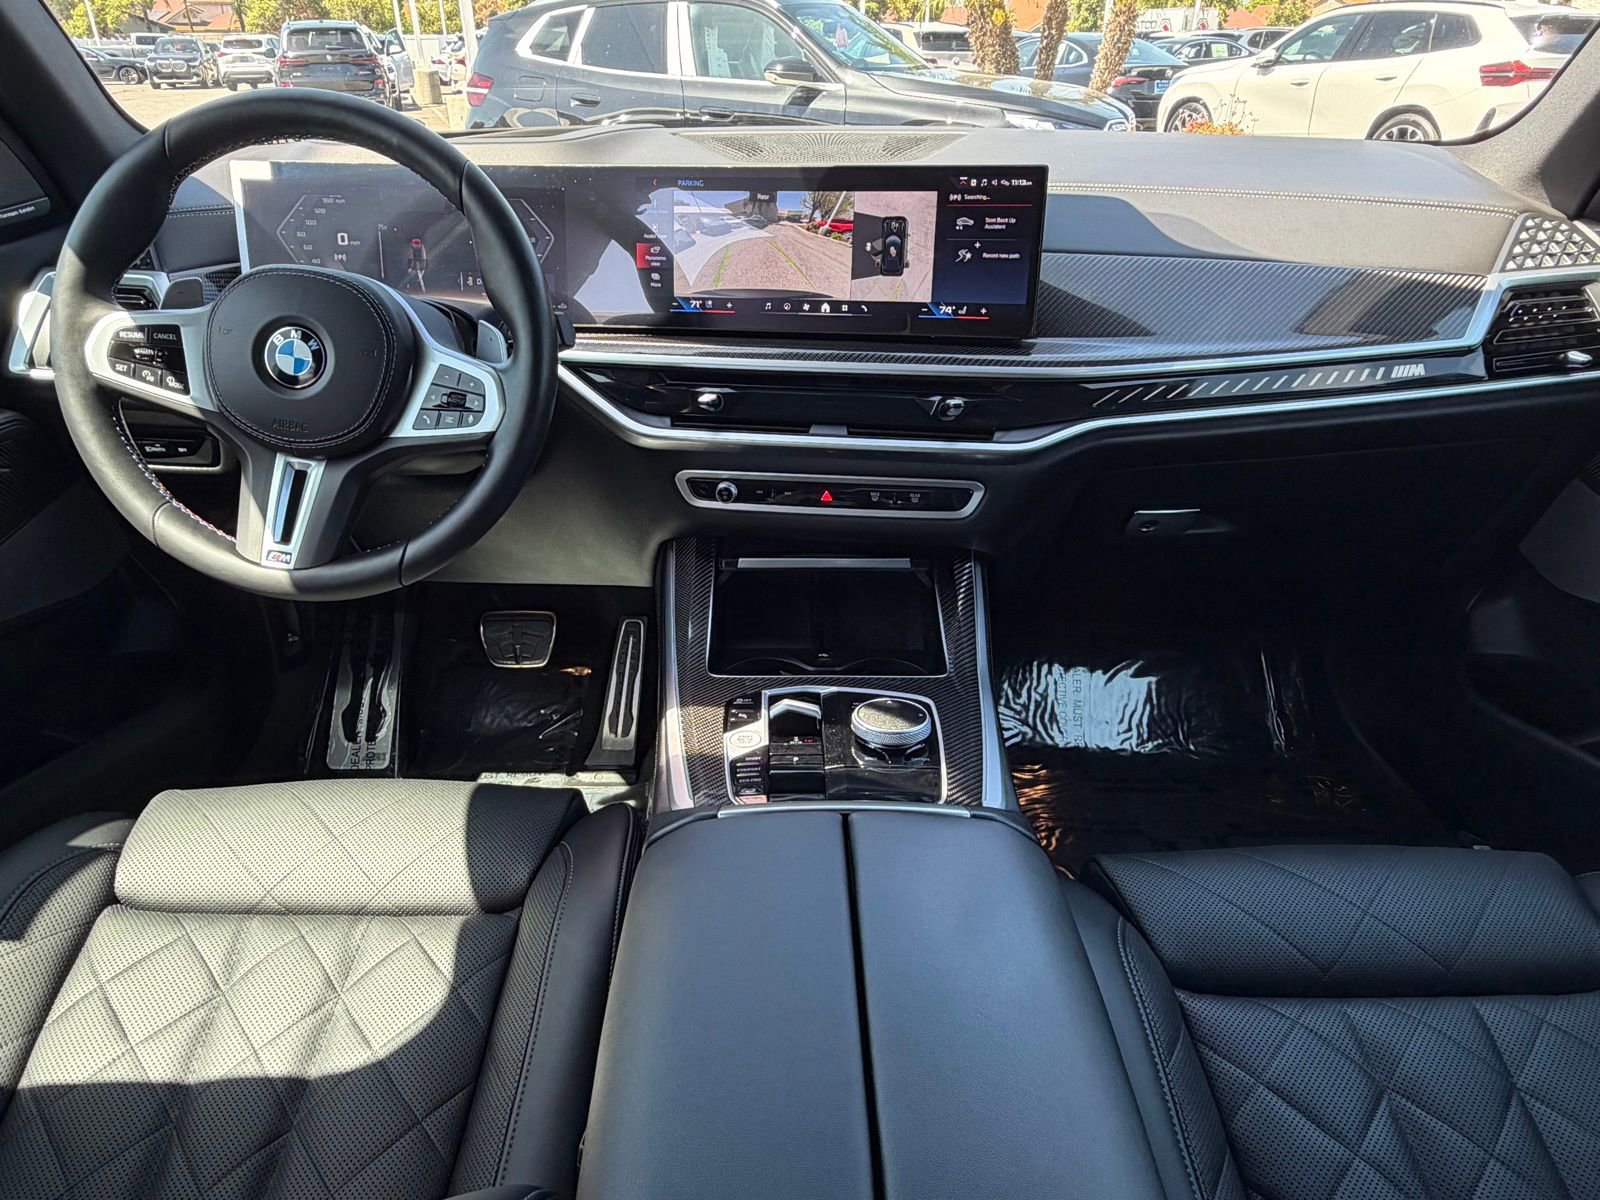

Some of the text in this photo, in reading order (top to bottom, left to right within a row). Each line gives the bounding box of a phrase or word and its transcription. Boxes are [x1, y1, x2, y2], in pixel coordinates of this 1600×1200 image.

[337, 232, 349, 245] 0
[153, 332, 177, 340] CANCEL
[272, 329, 320, 351] BMW
[115, 363, 128, 372] SET
[271, 417, 309, 433] AIRBAG
[1072, 699, 1084, 730] MUST
